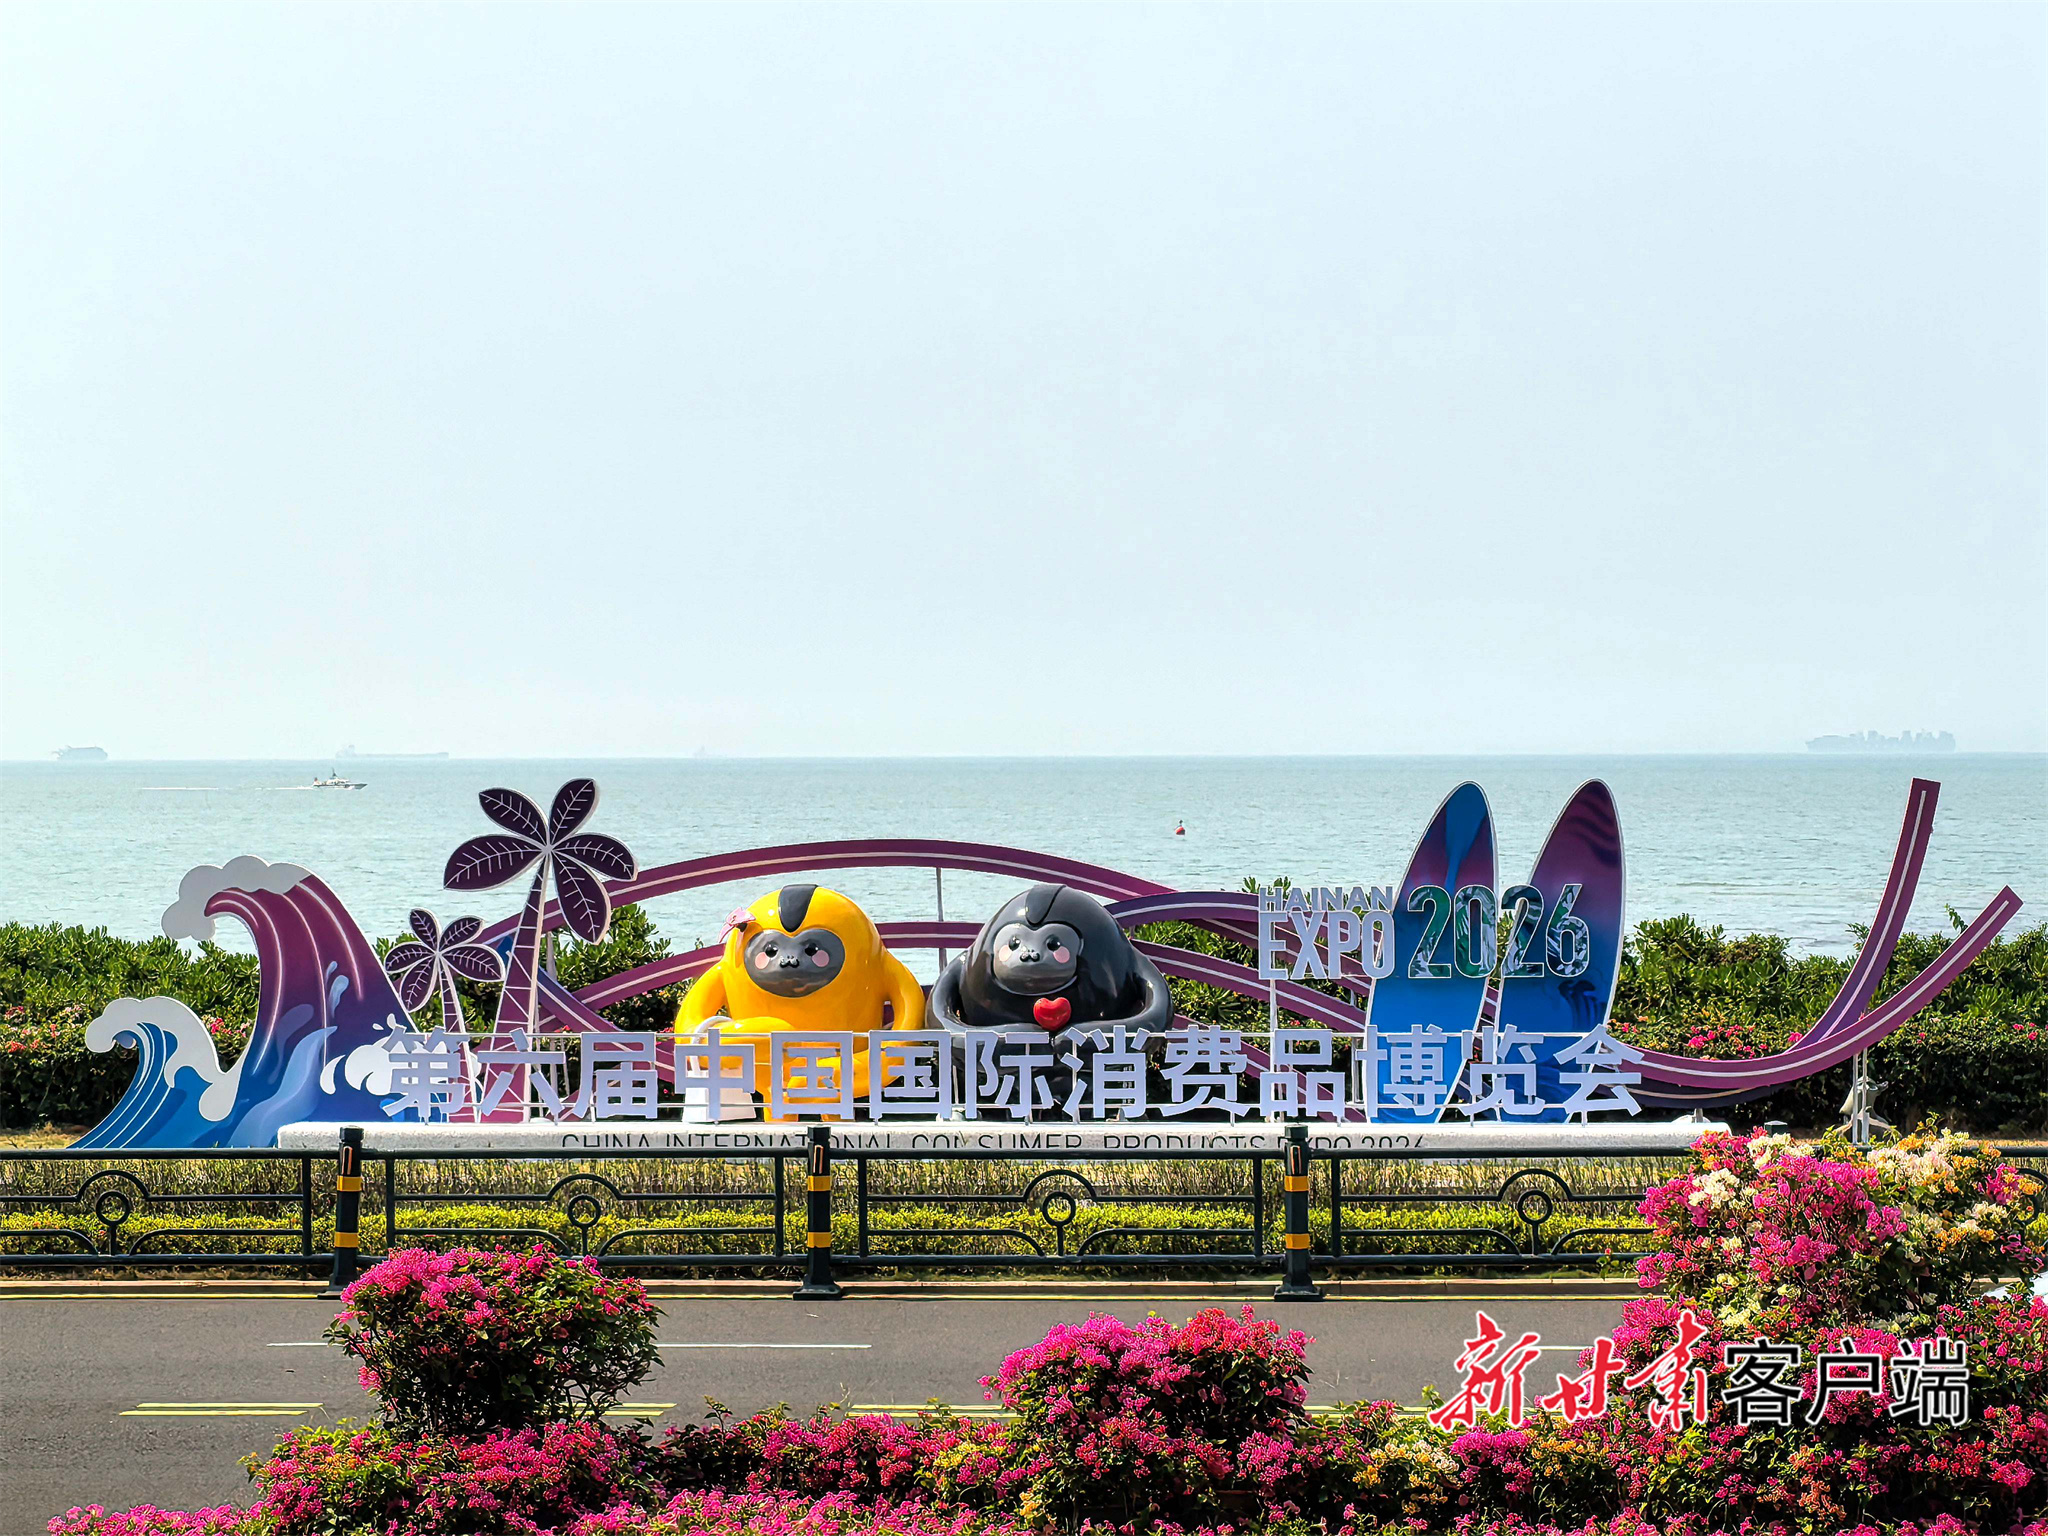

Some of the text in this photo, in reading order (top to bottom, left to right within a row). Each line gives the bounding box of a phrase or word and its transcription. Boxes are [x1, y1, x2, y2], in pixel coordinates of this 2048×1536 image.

[1259, 886, 1394, 912] HAINAN
[1258, 884, 1591, 980] EXPO 2026
[383, 1024, 1644, 1120] 第六届中国国际消费品博览会
[666, 1133, 890, 1149] INTERNATNAL
[912, 1133, 1083, 1149] COSUMER
